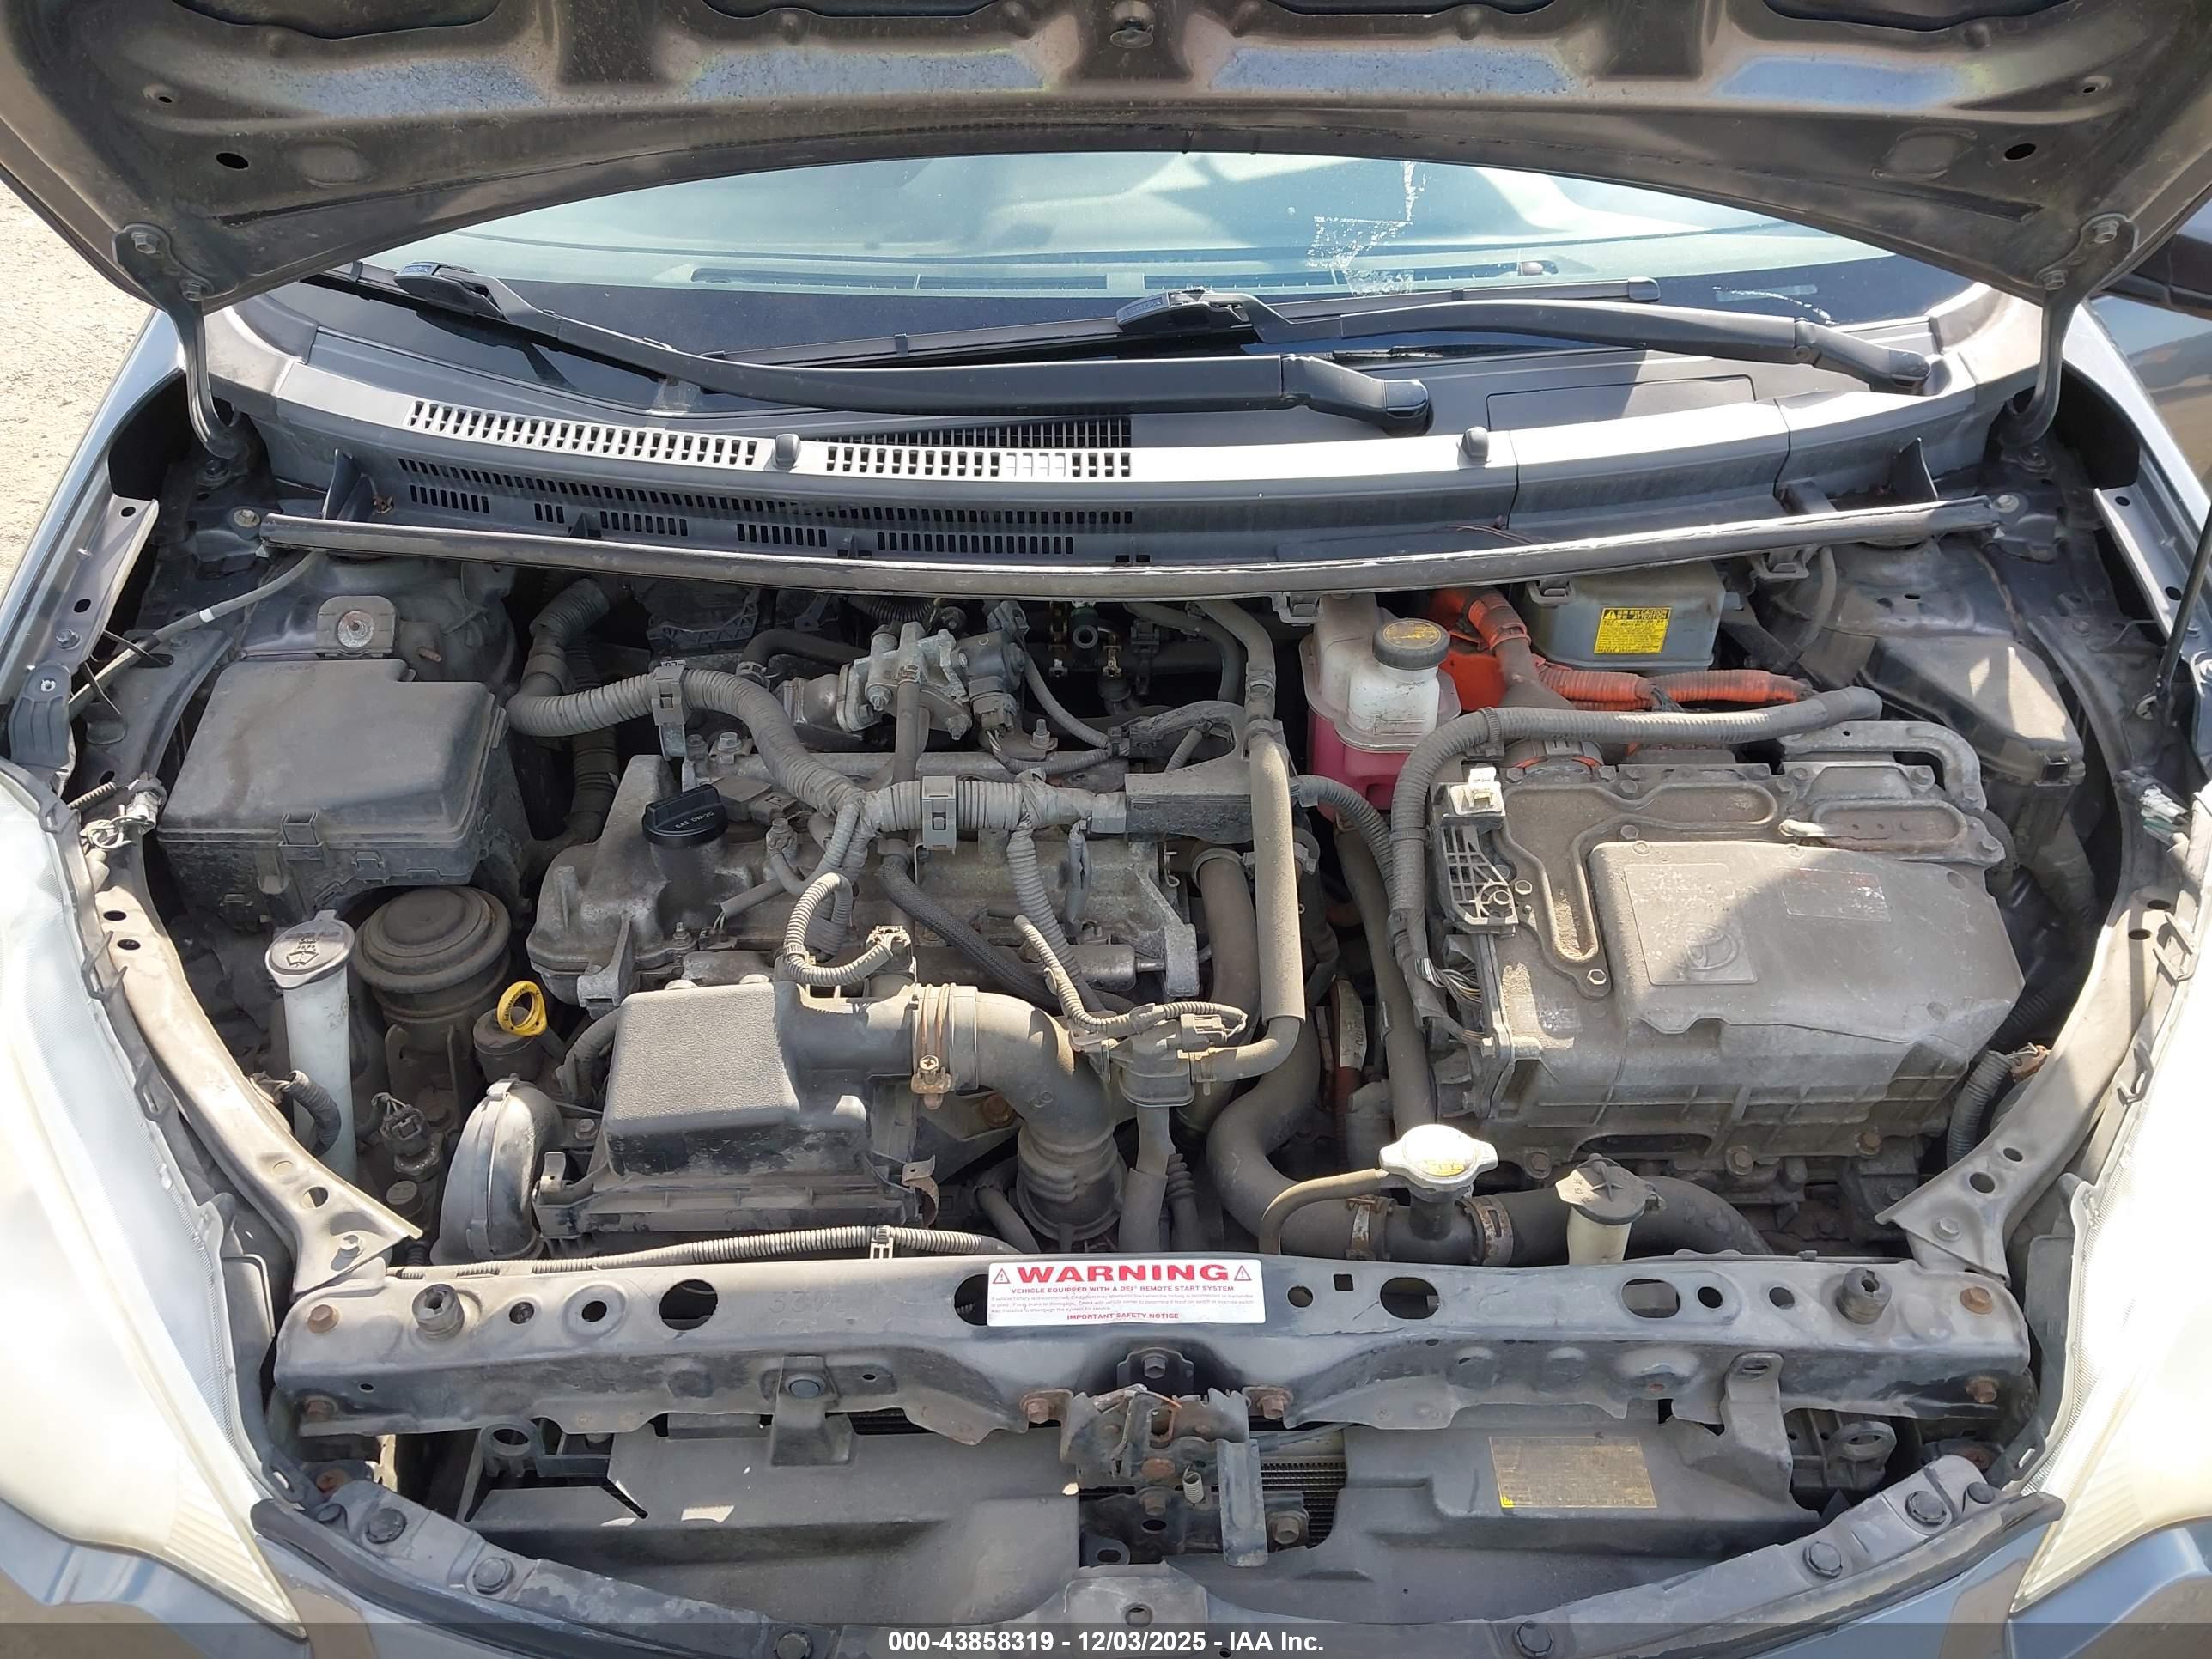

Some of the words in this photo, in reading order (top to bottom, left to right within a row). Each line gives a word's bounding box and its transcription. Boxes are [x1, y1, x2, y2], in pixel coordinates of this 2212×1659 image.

[675, 820, 690, 829] SAE
[690, 811, 714, 822] 0W-20
[1017, 1264, 1229, 1283] WARNING
